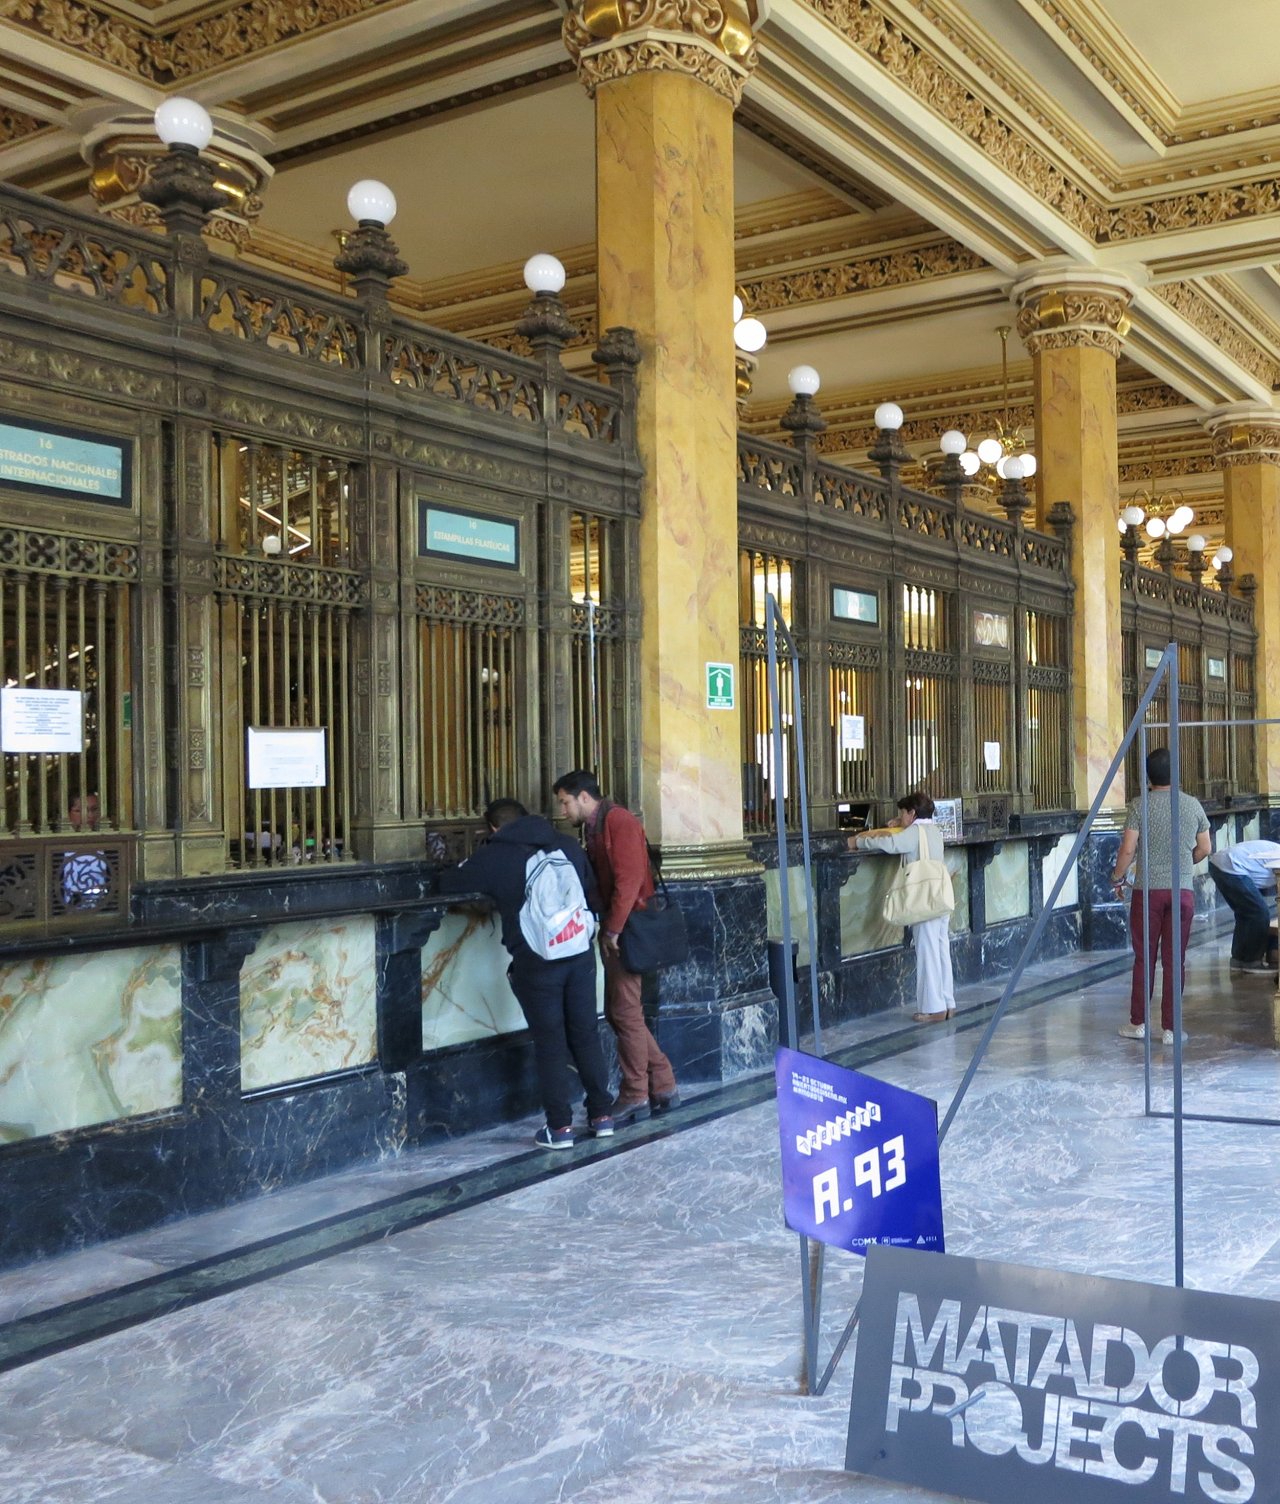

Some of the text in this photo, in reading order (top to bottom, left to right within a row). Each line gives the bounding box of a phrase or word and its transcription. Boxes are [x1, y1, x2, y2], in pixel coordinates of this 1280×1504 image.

[39, 438, 53, 450] 16
[0, 464, 100, 490] INTERNACIONALES
[51, 459, 118, 480] NACIONALES
[808, 1102, 879, 1148] ABIERTO
[812, 1134, 906, 1225] A.93
[851, 1236, 878, 1247] CDMX
[892, 1291, 1260, 1429] MATADOR
[885, 1362, 1256, 1504] PROJECTS
